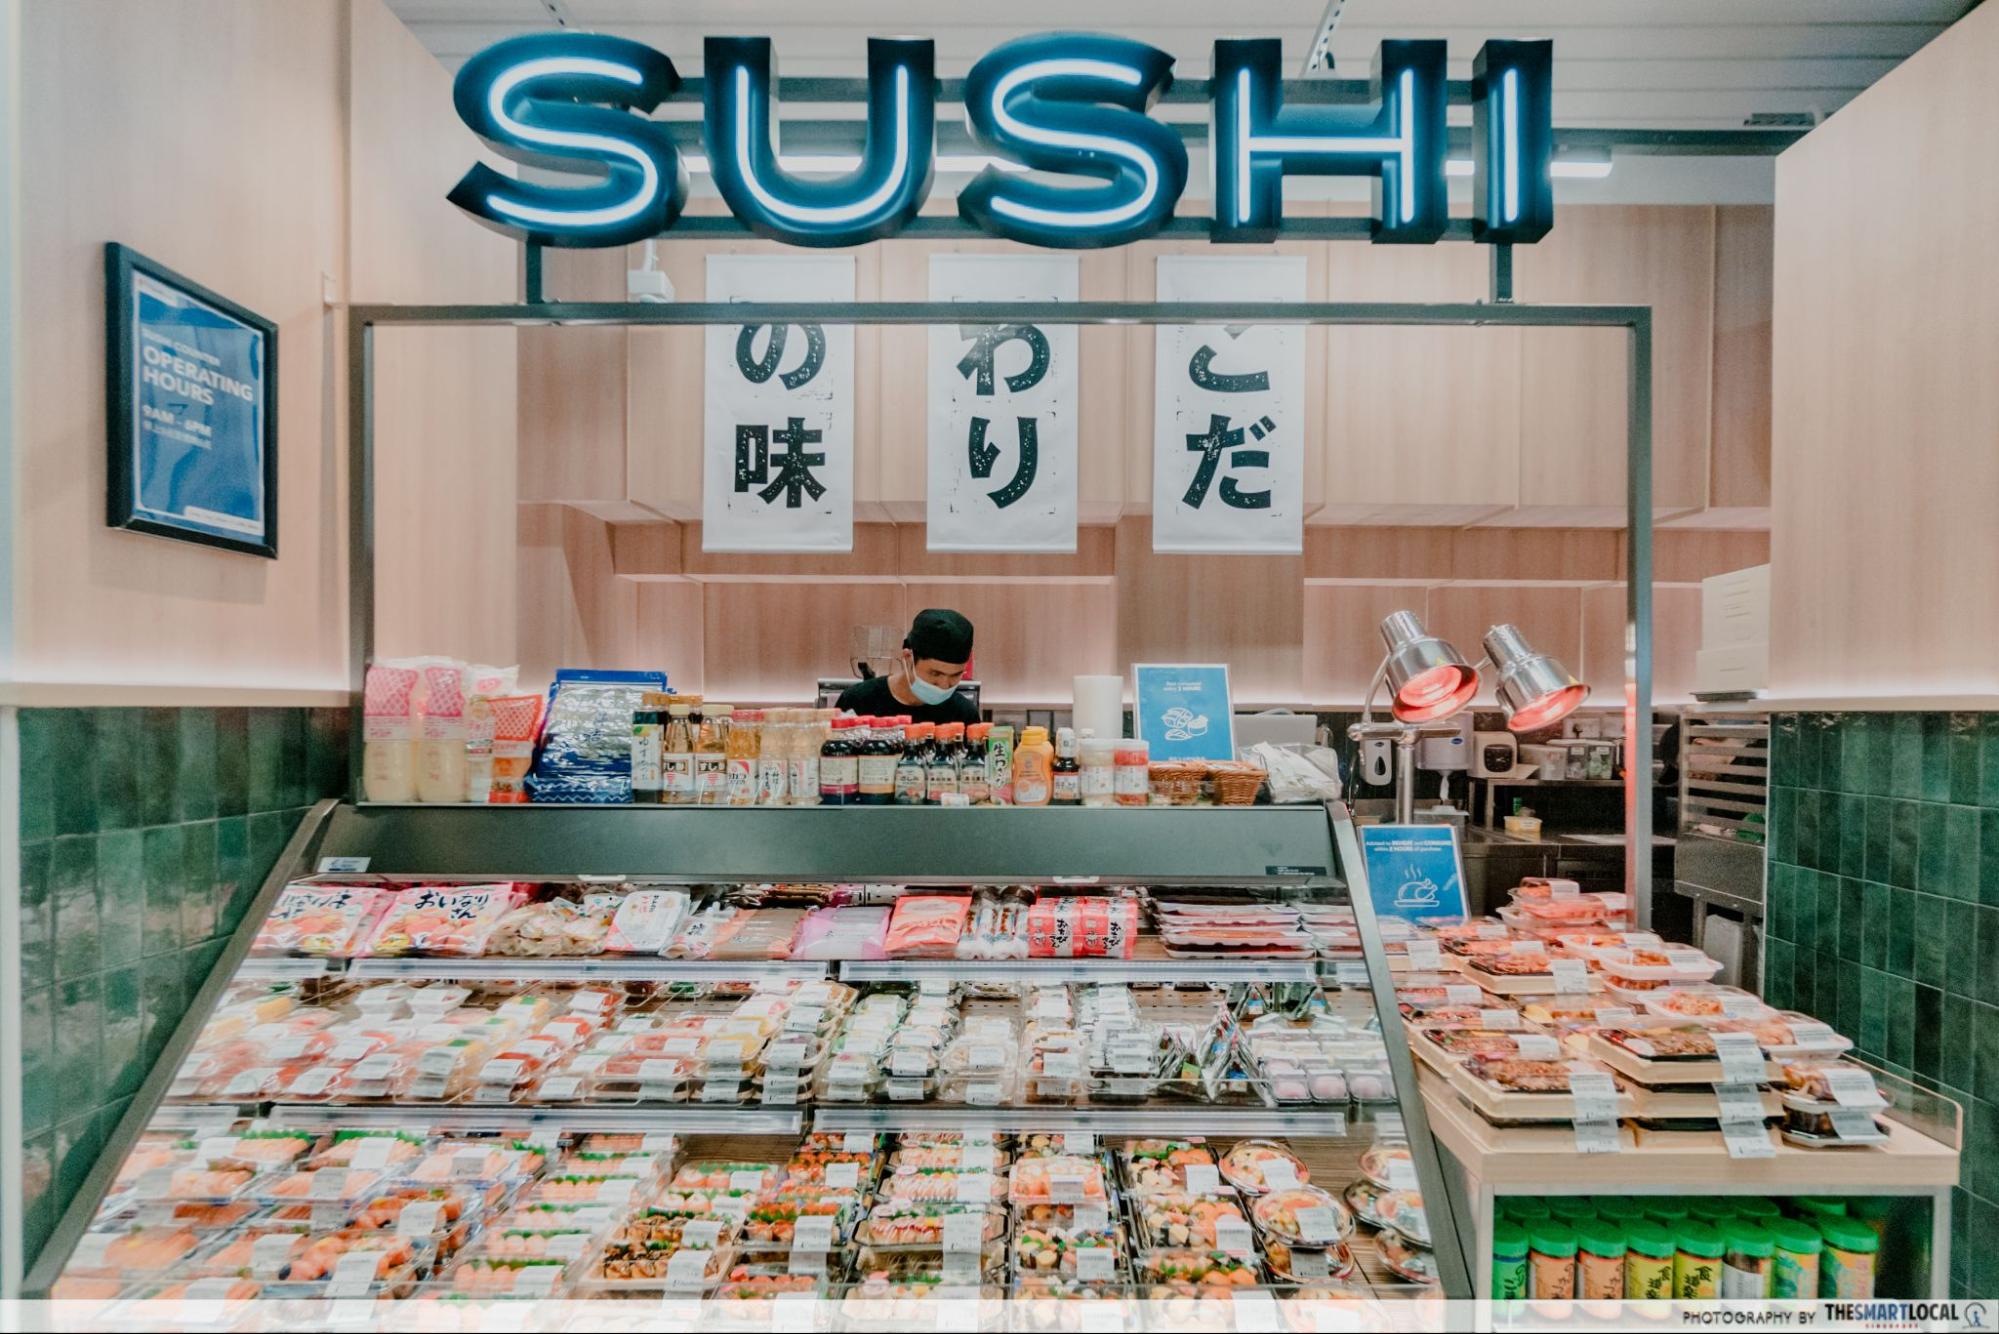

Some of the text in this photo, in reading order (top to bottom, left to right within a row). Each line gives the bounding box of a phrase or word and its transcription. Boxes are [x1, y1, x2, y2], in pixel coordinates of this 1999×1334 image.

[447, 32, 1555, 247] SUSHI
[143, 345, 254, 402] OPERATING
[143, 365, 214, 405] HOURS
[733, 323, 828, 510] の味
[956, 323, 1051, 510] わり
[1181, 323, 1277, 511] こだ
